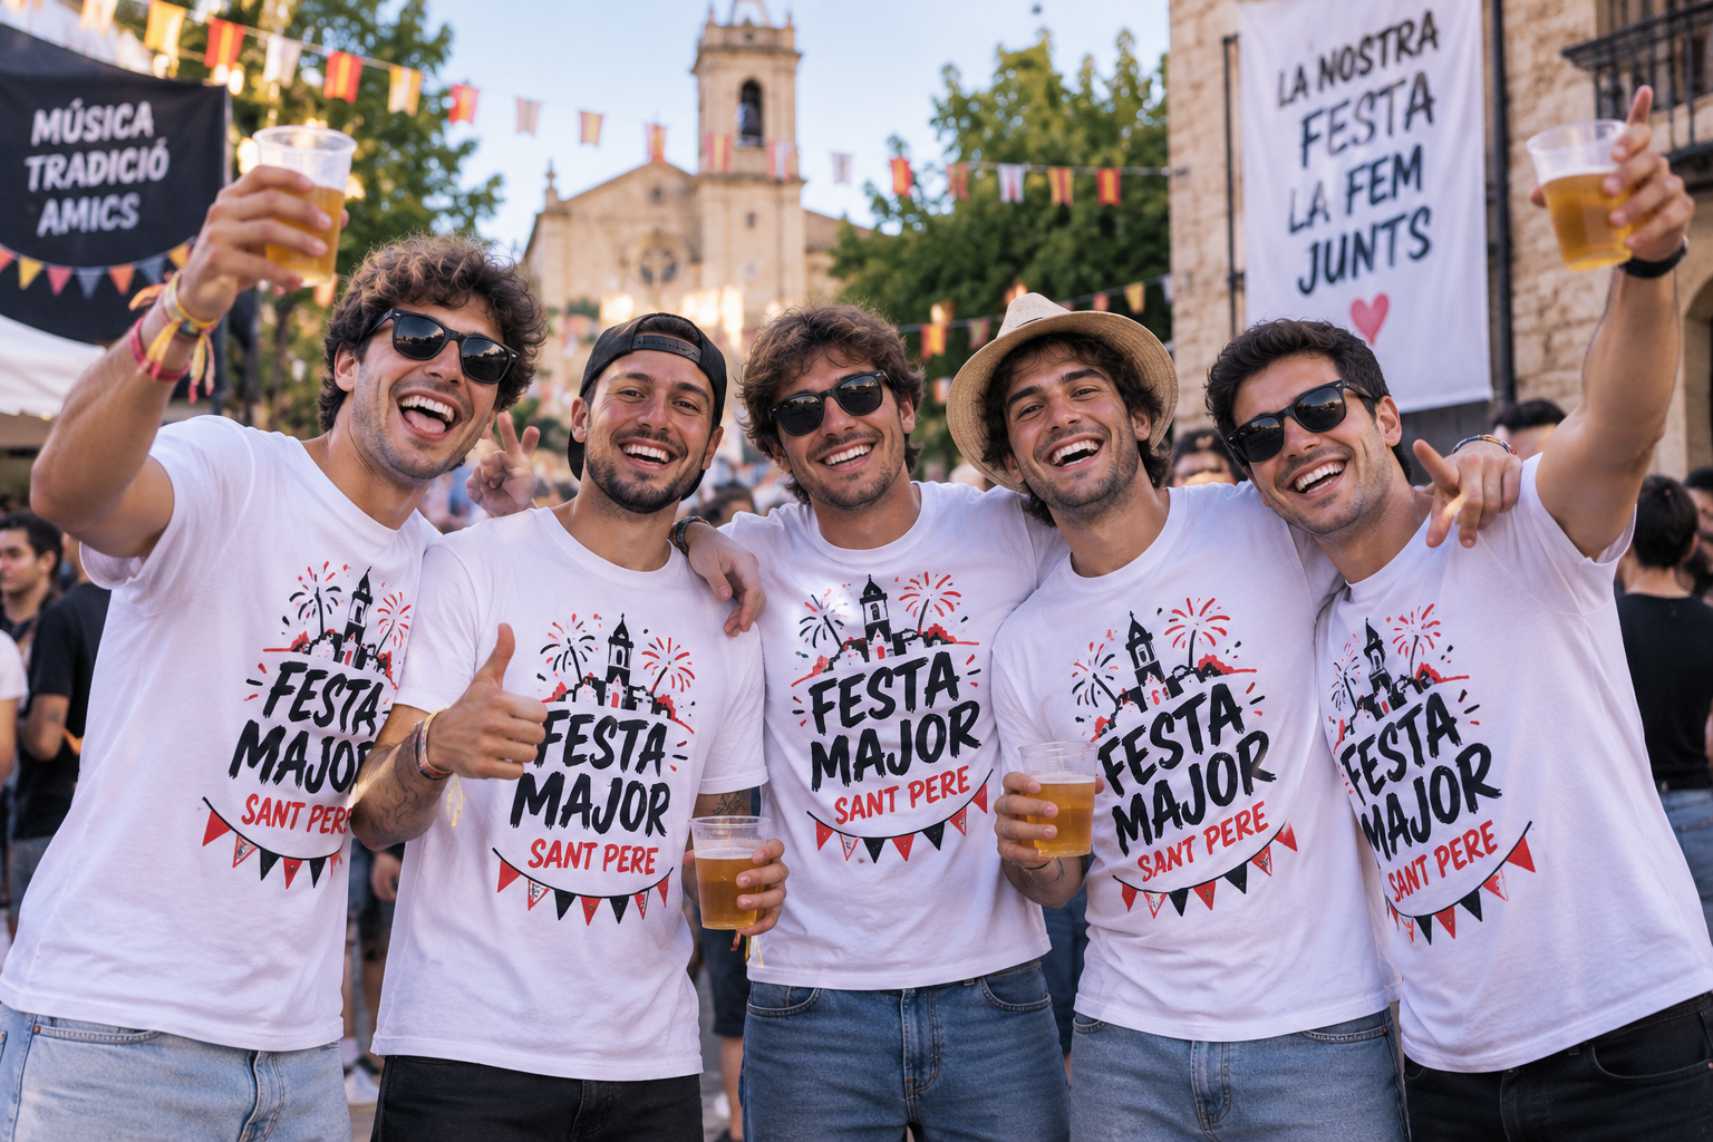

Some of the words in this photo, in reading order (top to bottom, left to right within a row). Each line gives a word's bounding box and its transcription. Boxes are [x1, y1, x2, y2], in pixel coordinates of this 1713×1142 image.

[1278, 64, 1309, 108] LA
[1317, 9, 1439, 93] NOSTRA
[31, 97, 154, 146] MÚSICA
[1301, 71, 1435, 169] FESTA
[24, 137, 170, 191] TRADICIÓ
[1288, 179, 1330, 235] LA
[1346, 144, 1423, 216] FEM
[36, 192, 140, 238] AMICS
[1298, 205, 1432, 296] JUNTS
[262, 660, 386, 737] FESTA
[808, 651, 961, 736] FESTA
[534, 708, 668, 777] FESTA
[810, 700, 982, 792] MAJOR
[1097, 683, 1245, 798] FESTA
[1340, 692, 1463, 806] FESTA
[241, 793, 305, 831] SANT
[306, 803, 353, 835] PER
[509, 771, 671, 838] MAJOR
[834, 785, 899, 826] SANT
[907, 765, 971, 808] PERE
[1111, 730, 1277, 857] MAJOR
[1360, 743, 1503, 863] MAJOR
[527, 838, 598, 871] SANT
[602, 844, 659, 875] PERE
[1137, 835, 1196, 882] SANT
[1205, 800, 1270, 856] PERE
[1387, 854, 1430, 903] SANT
[1434, 819, 1499, 879] PERE
